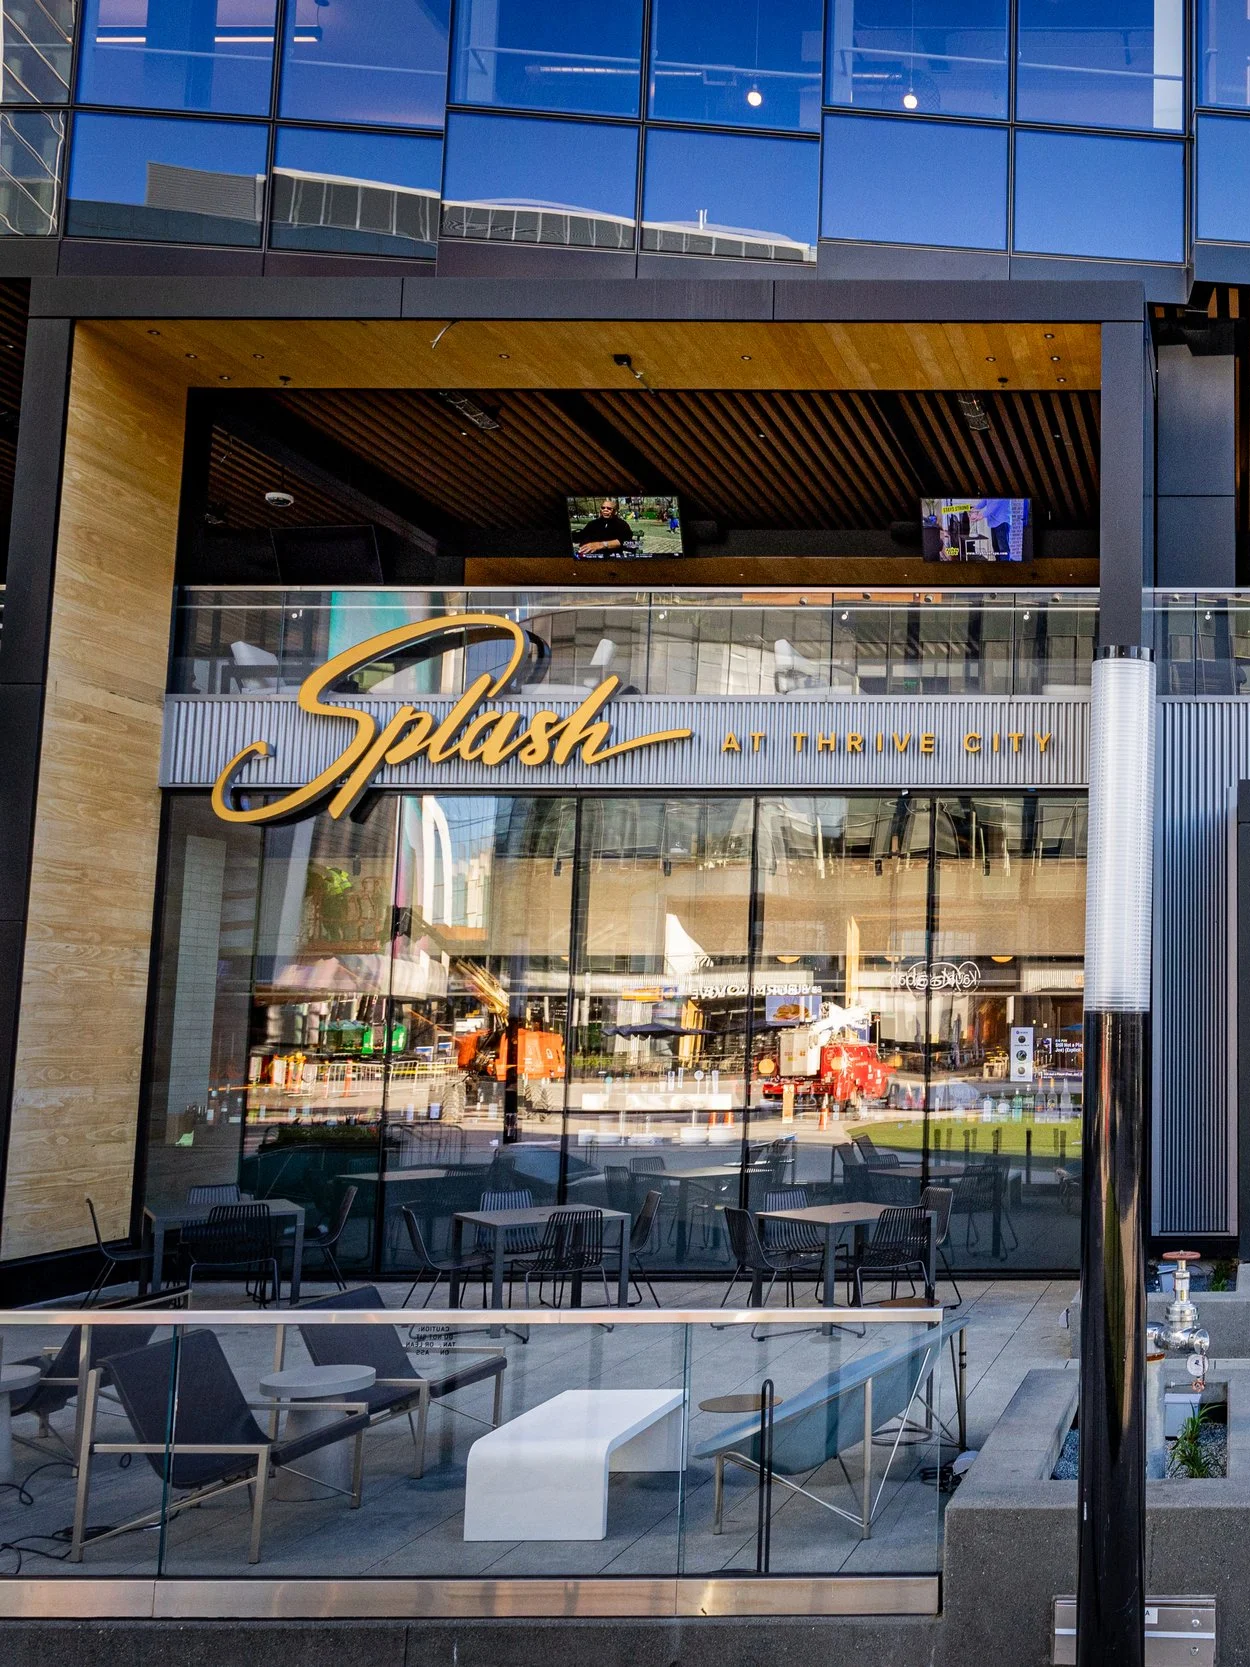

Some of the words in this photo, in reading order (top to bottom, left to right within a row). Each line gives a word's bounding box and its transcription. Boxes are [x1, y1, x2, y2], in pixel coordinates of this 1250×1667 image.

[211, 613, 692, 824] Splash
[721, 731, 766, 754] AT
[792, 731, 936, 754] THRIVE
[963, 731, 1056, 754] CITY
